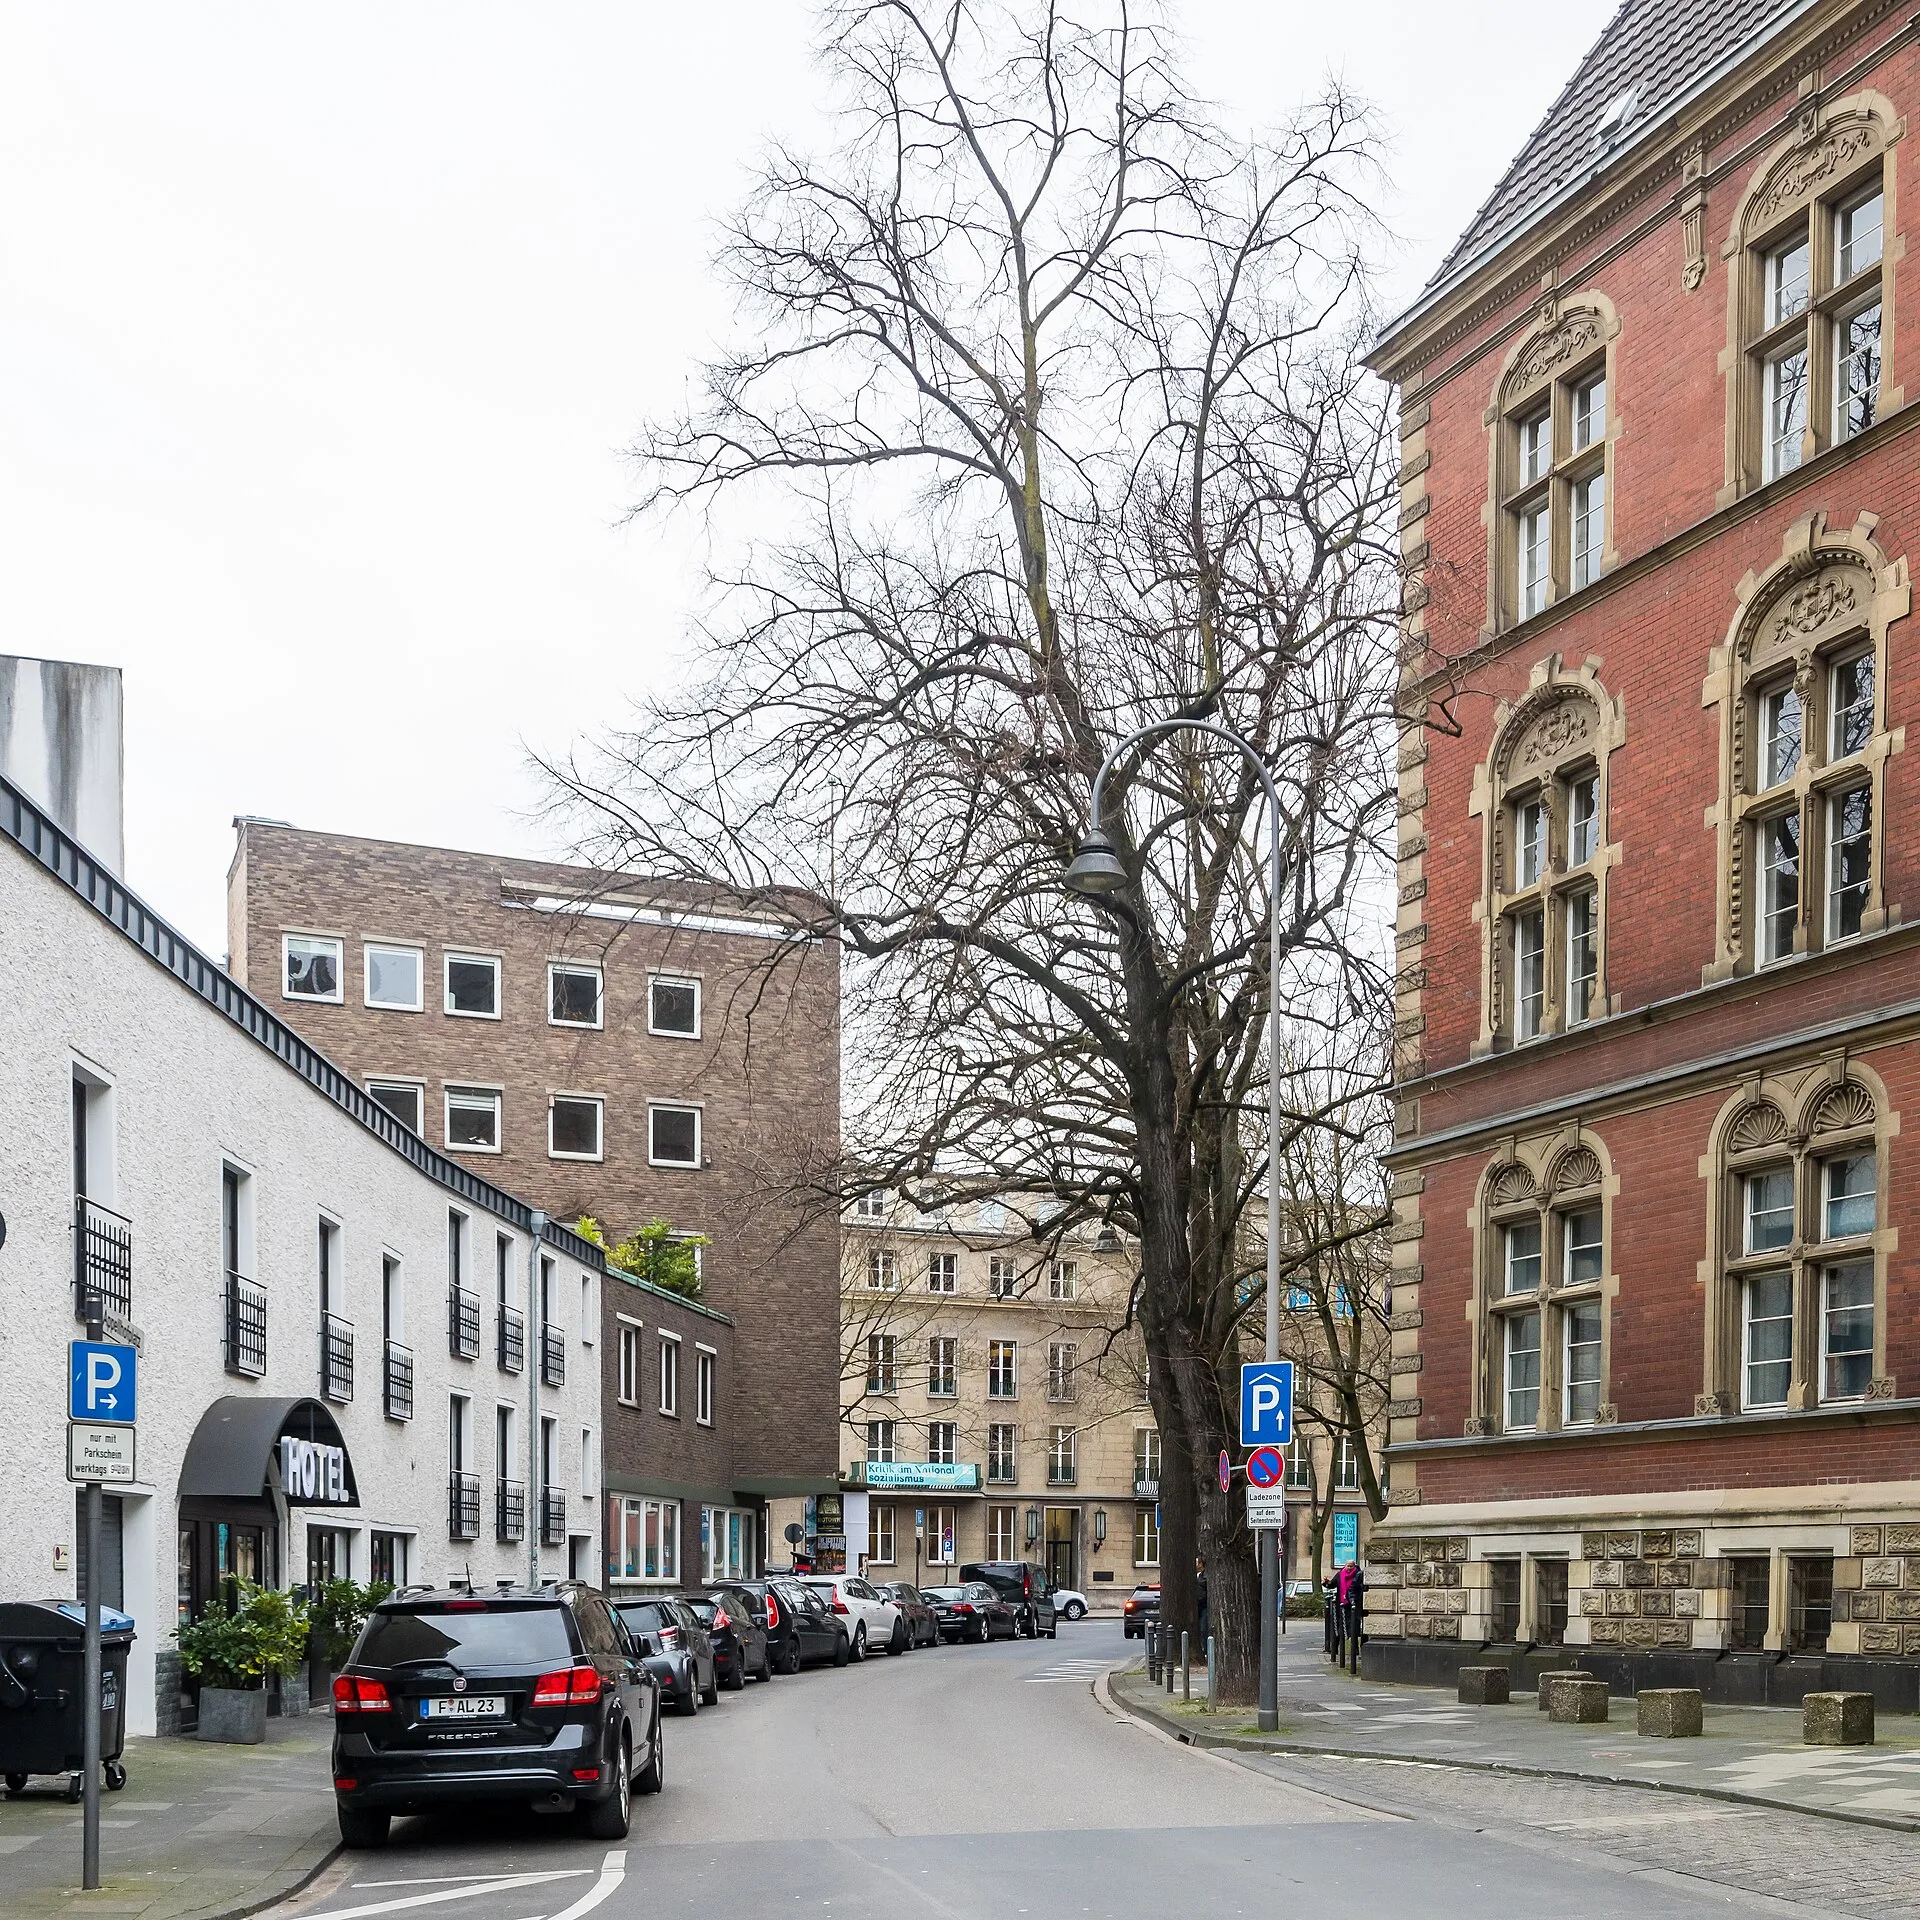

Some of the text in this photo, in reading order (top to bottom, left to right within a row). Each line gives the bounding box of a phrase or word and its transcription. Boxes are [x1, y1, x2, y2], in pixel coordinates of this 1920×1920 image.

[87, 1352, 122, 1410] P
[1252, 1384, 1280, 1432] P
[89, 1433, 117, 1444] nur mit
[84, 1446, 122, 1460] Parkschein
[74, 1463, 108, 1477] werktags
[280, 1435, 349, 1503] HOTEL
[868, 1464, 894, 1474] Kritik
[868, 1474, 925, 1483] sozialismus
[1249, 1493, 1281, 1501] Ladezone
[1250, 1516, 1282, 1524] Seitenstreifen
[438, 1699, 495, 1714] F AL 23
